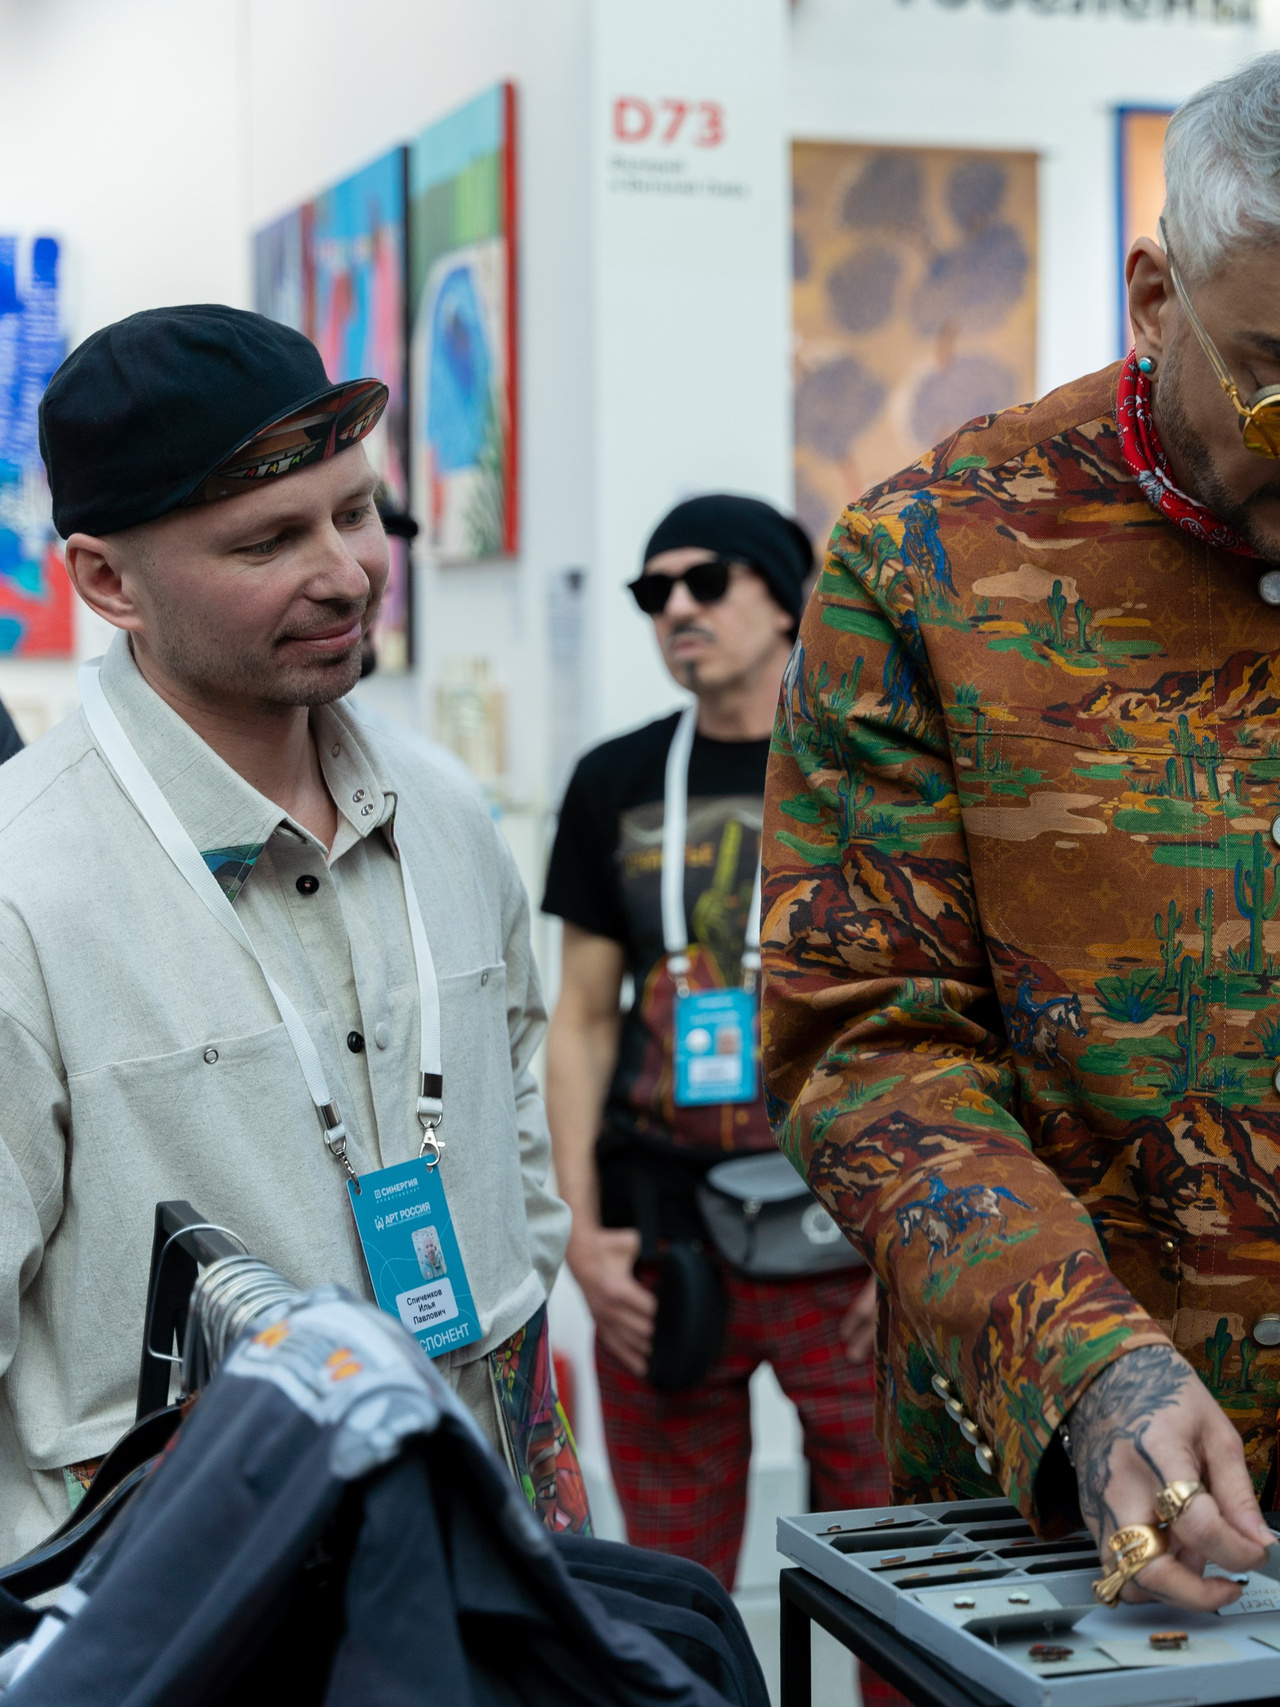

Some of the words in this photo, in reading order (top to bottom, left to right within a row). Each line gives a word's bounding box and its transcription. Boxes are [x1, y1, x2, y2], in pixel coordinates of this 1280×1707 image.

[612, 97, 726, 149] D73
[381, 1177, 419, 1196] СИНЕРГИЯ
[385, 1211, 399, 1225] АРТ
[399, 1201, 431, 1220] РОССИЯ
[406, 1289, 443, 1306] Спиченков
[418, 1301, 437, 1313] Илья
[413, 1308, 447, 1325] Павлович
[419, 1322, 469, 1352] СПОНЕНТ
